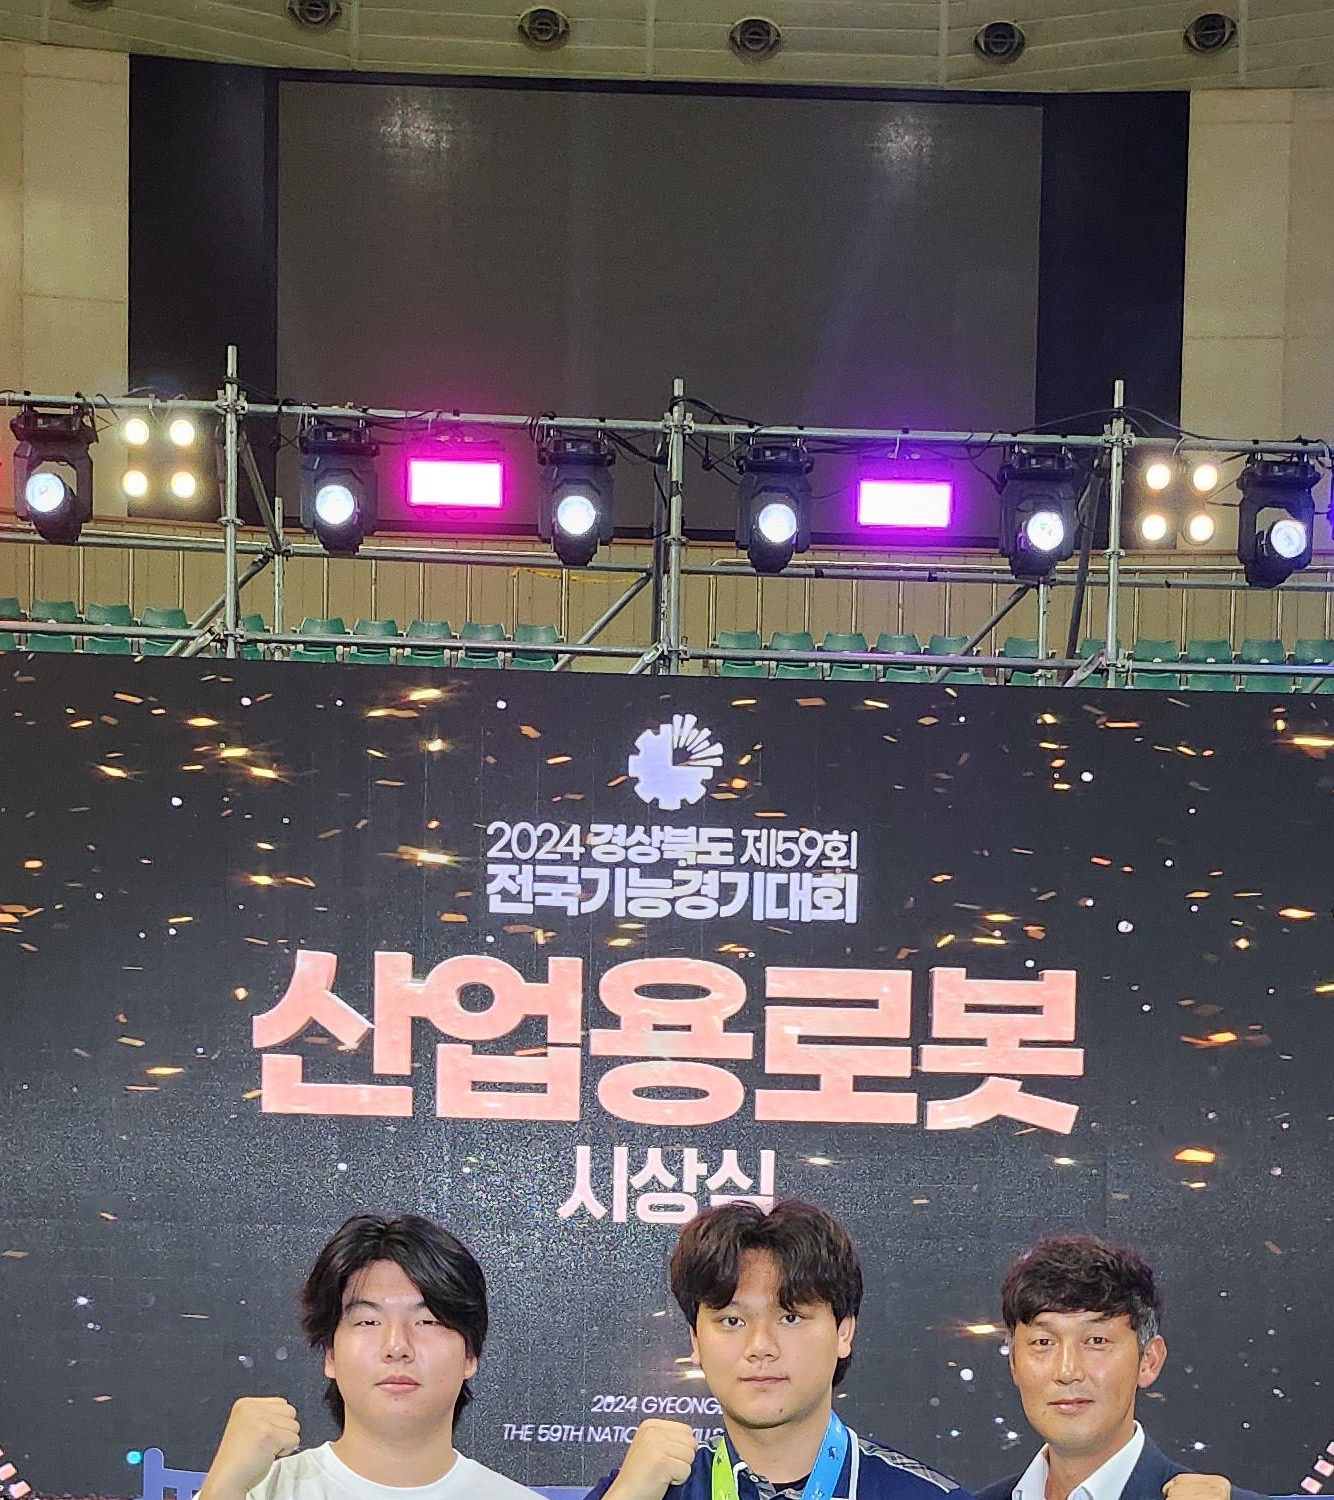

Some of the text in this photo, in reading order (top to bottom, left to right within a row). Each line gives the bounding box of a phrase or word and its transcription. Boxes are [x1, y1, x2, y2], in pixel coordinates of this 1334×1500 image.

[487, 821, 859, 872] 2024 경상북도 제59회
[485, 864, 859, 925] 전국기능경기대회
[252, 949, 1085, 1134] 산업용로봇
[557, 1145, 776, 1224] 시상식
[502, 1423, 533, 1441] THE
[536, 1424, 585, 1443] 59TH
[590, 1395, 724, 1415] 2024 GYEONG
